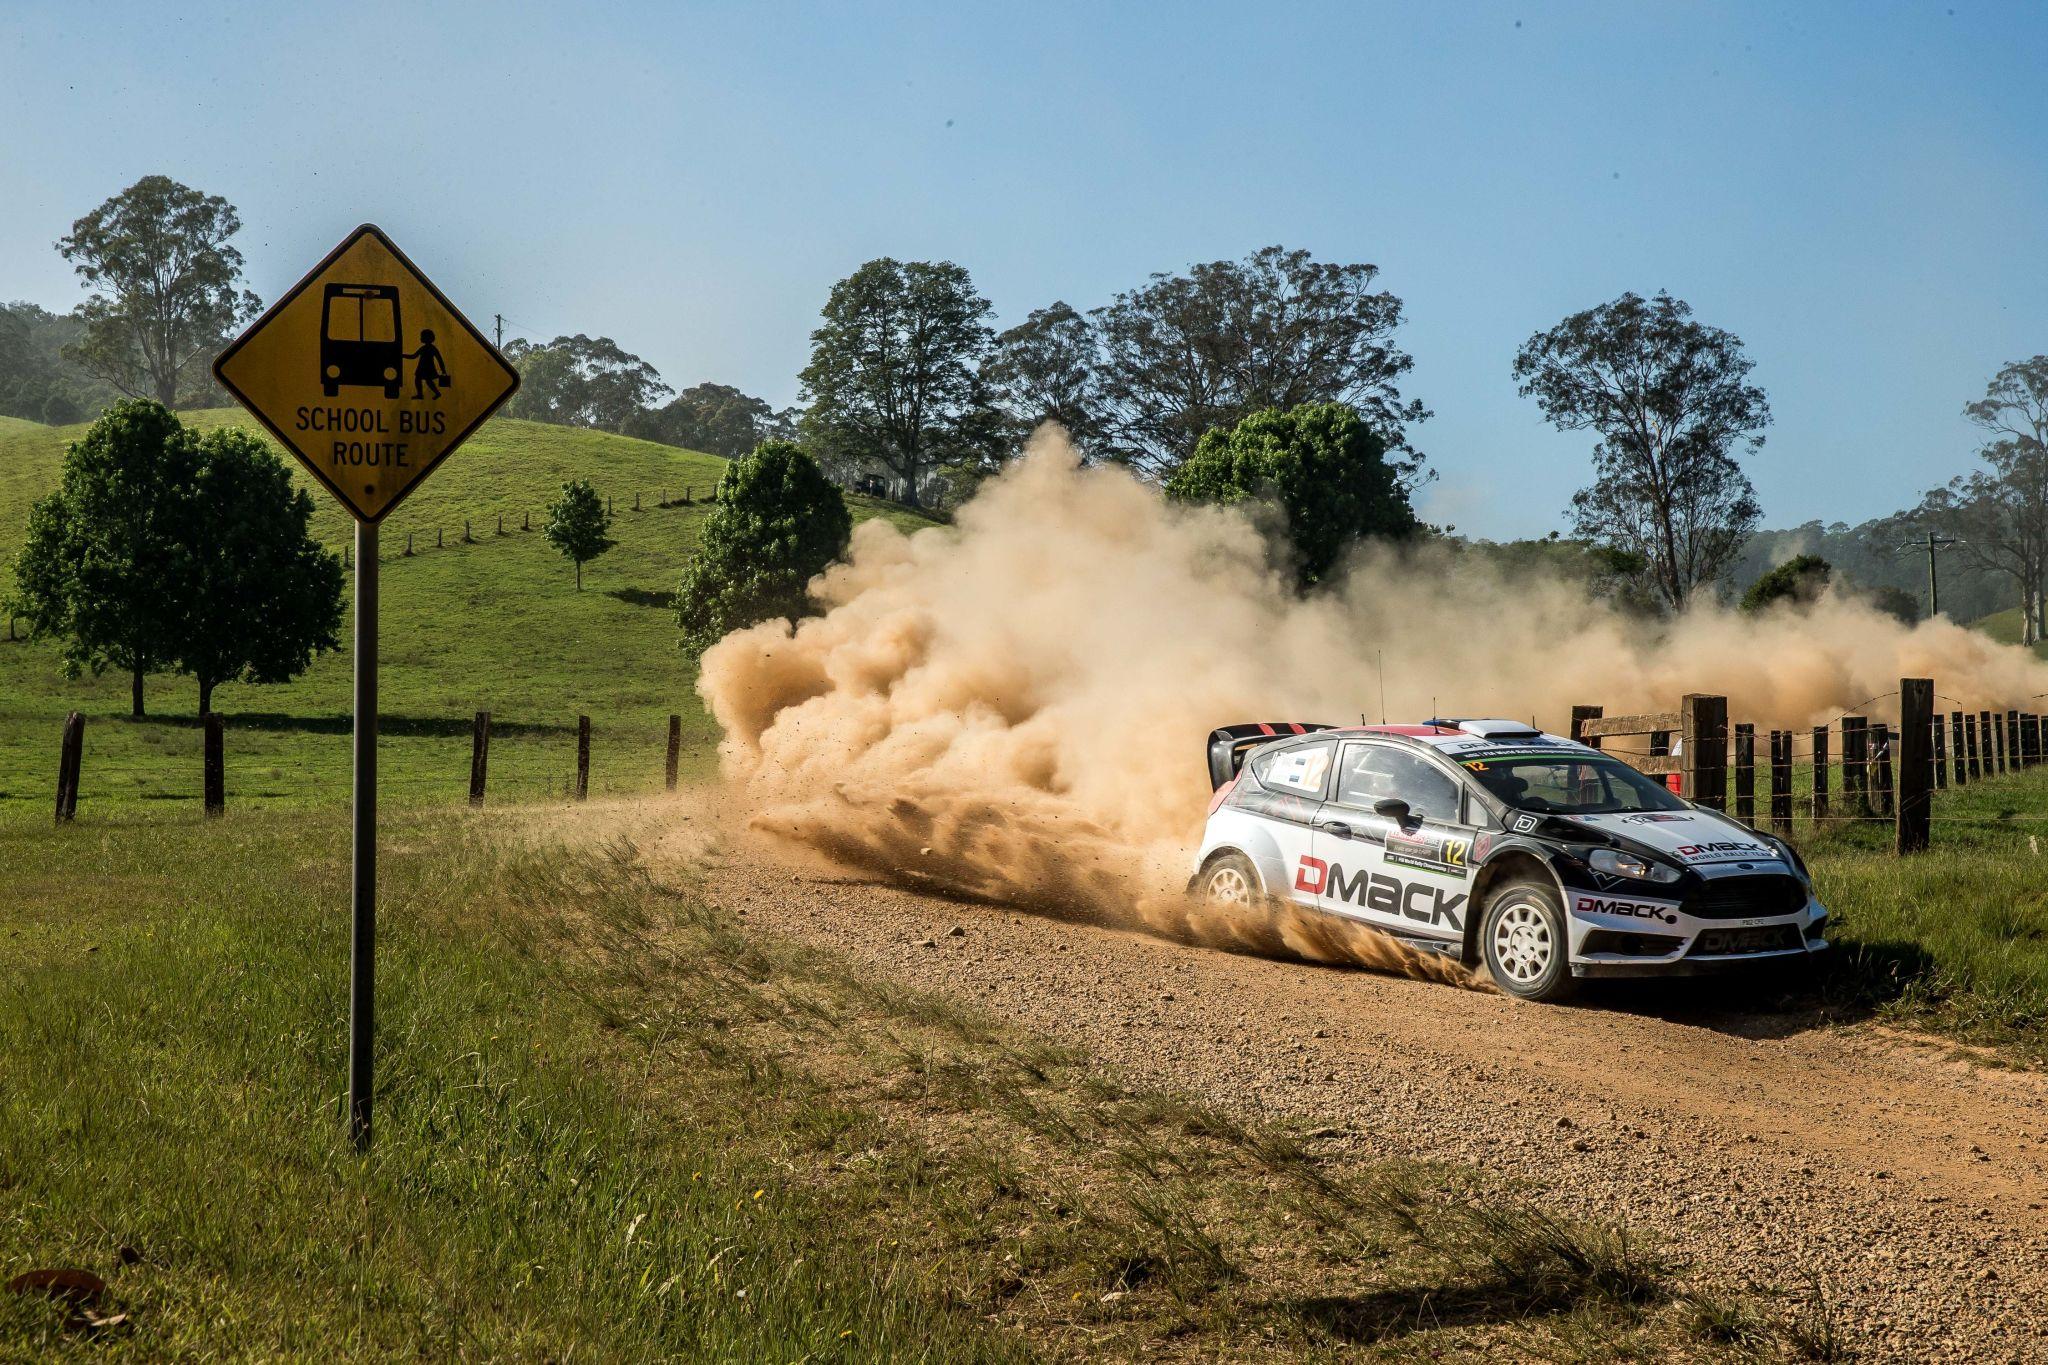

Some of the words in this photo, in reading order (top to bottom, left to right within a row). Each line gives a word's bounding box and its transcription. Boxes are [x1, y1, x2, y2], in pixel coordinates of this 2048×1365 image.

[295, 406, 389, 433] SCHOOL
[399, 410, 446, 435] BUS
[333, 441, 409, 467] ROUTE
[1465, 761, 1490, 772] 12
[1446, 839, 1467, 866] 12
[1690, 852, 1722, 863] WORLD
[1723, 851, 1750, 860] RALLY
